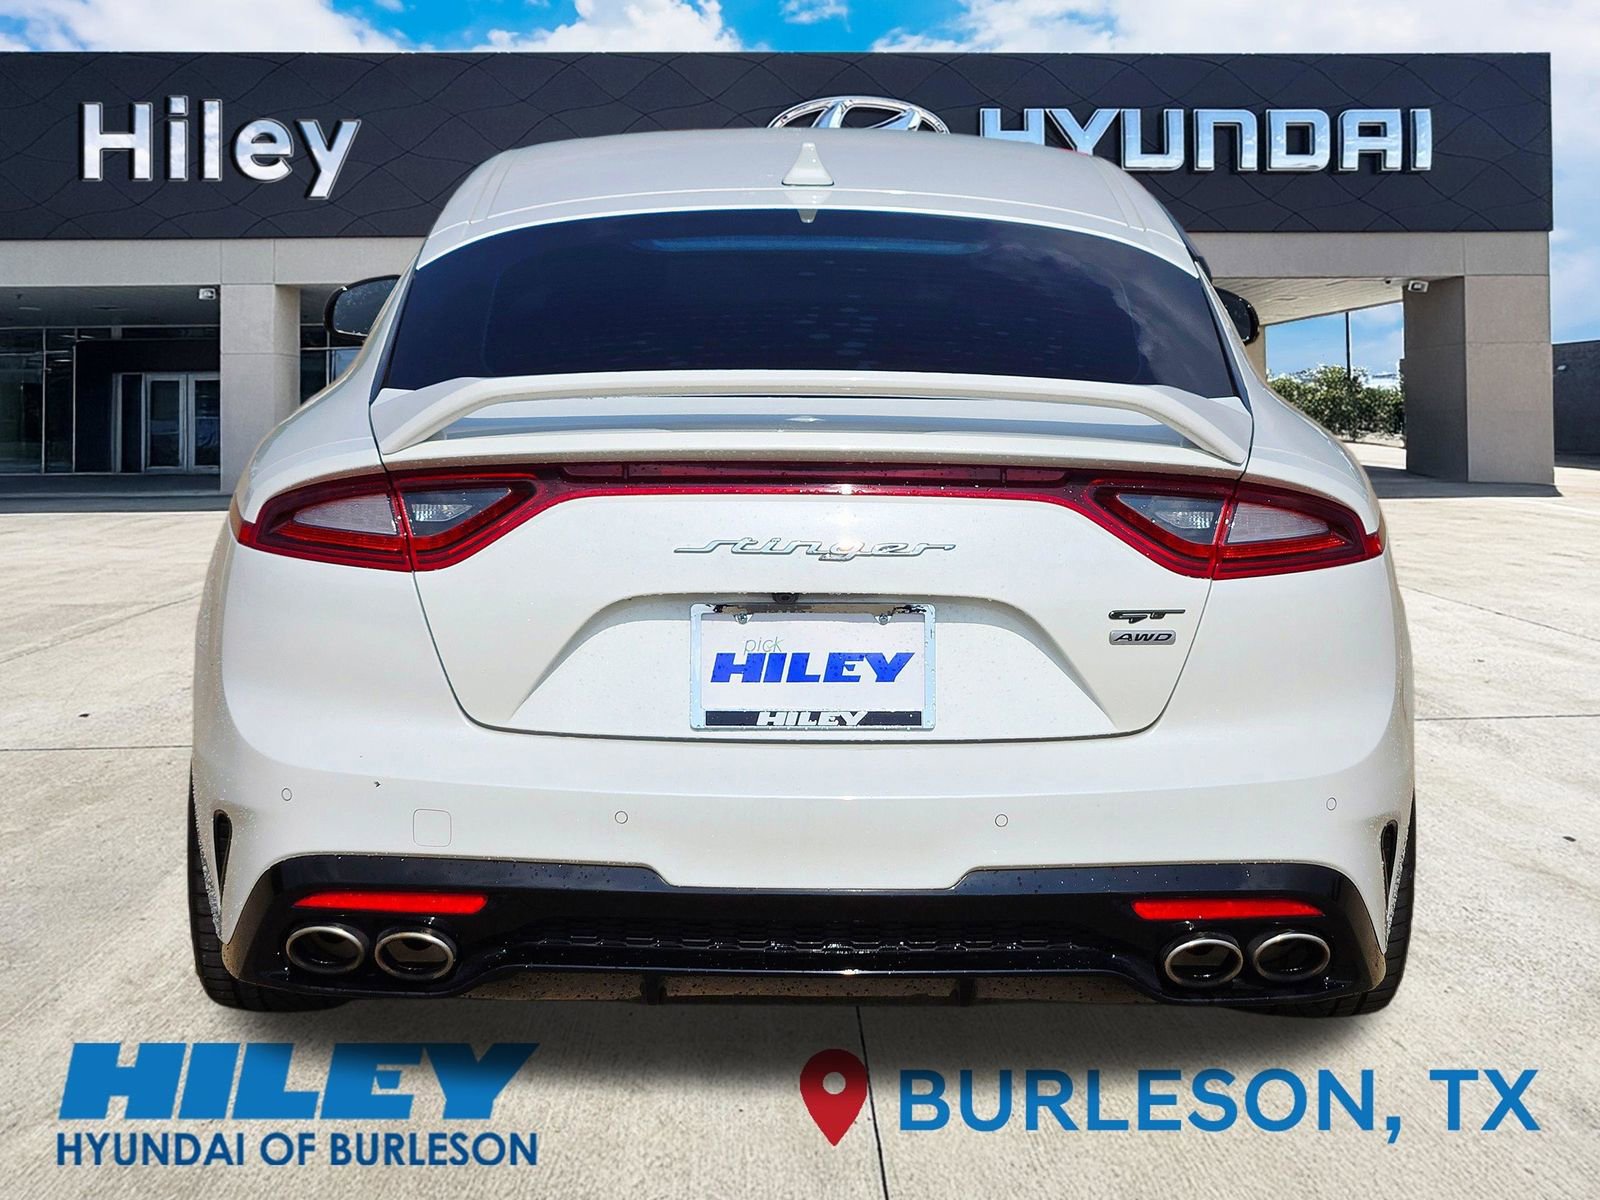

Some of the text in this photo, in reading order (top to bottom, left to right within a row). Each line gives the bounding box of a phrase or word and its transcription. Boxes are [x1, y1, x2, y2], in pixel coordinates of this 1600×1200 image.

[79, 94, 362, 200] Hiley
[673, 537, 956, 561] stinger
[1108, 609, 1186, 624] GT
[743, 636, 784, 655] pick
[1112, 632, 1173, 643] AWD
[710, 652, 915, 683] HILEY
[756, 711, 868, 726] HILEY
